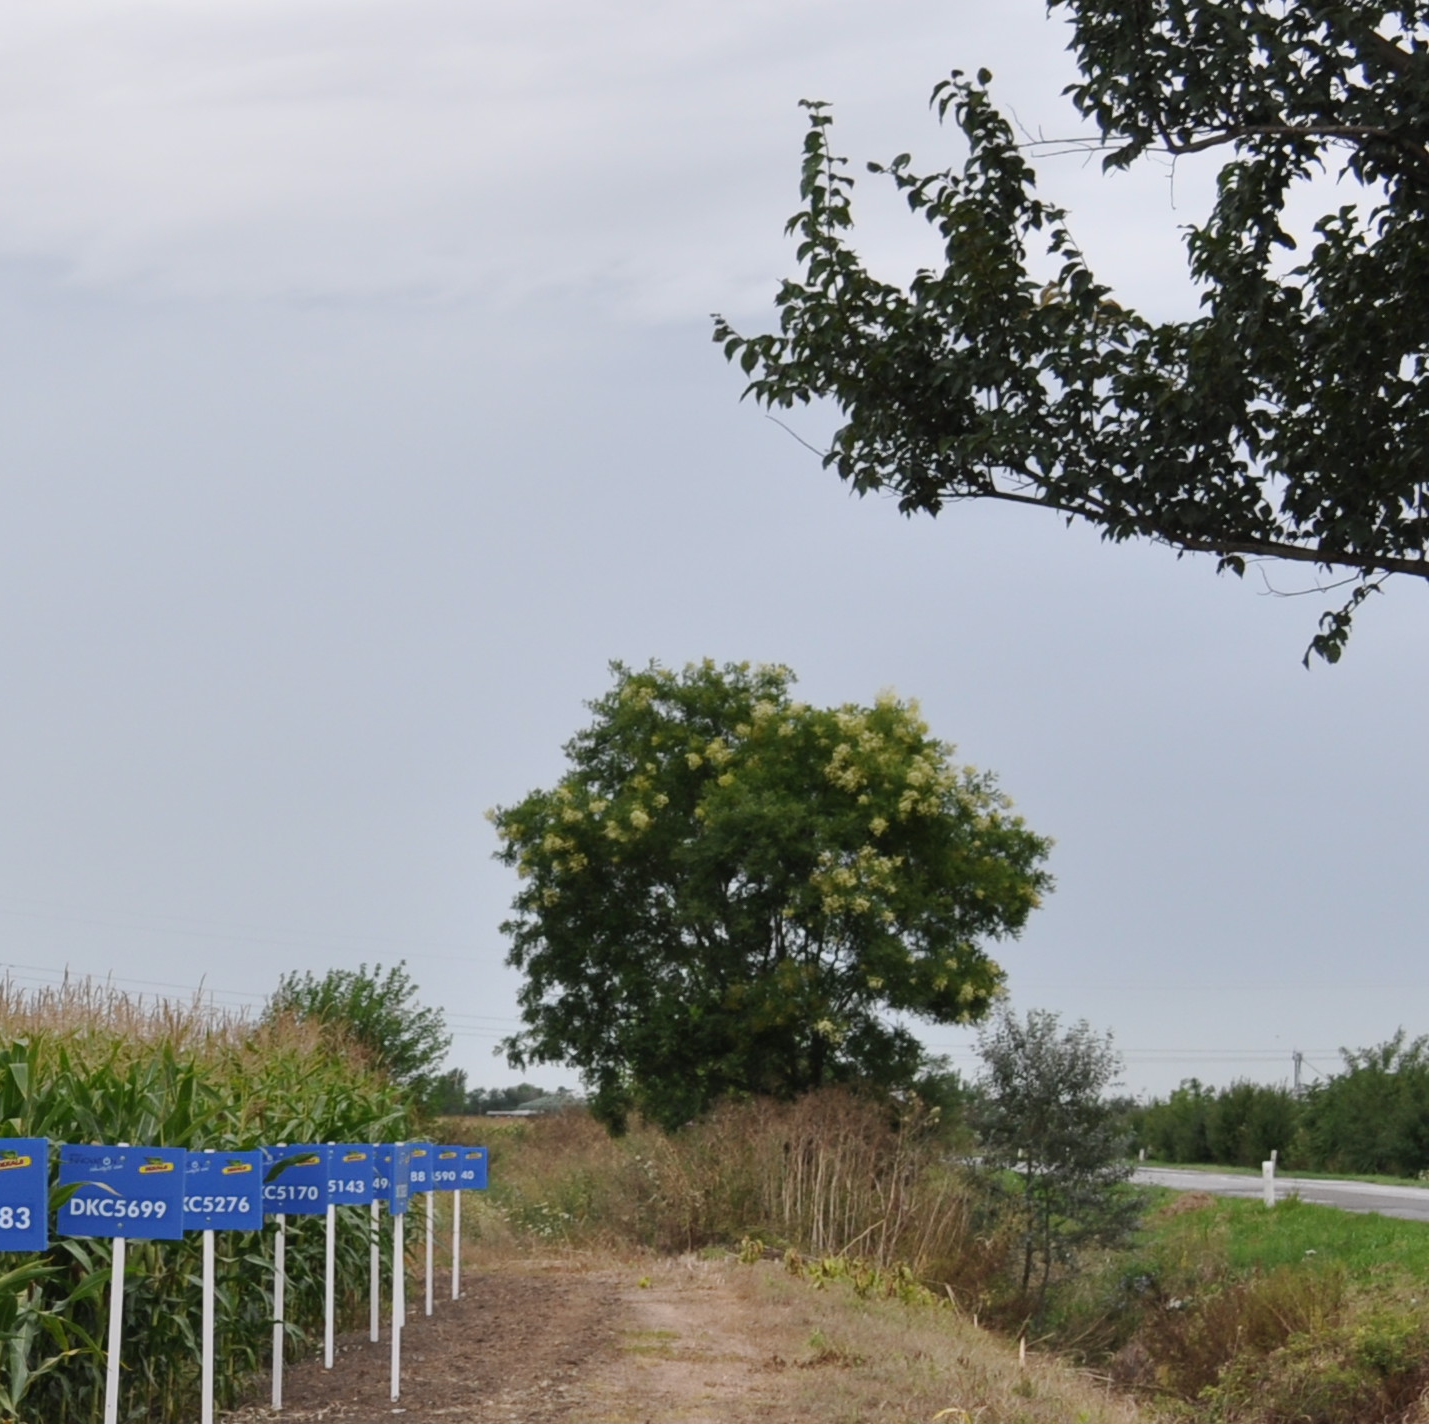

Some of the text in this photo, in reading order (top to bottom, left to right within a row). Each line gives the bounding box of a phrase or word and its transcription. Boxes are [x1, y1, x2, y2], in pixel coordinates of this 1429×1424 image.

[432, 1170, 456, 1181] 590
[262, 1185, 319, 1200] C5170
[328, 1180, 365, 1193] 5143
[70, 1198, 167, 1218] DKC5699
